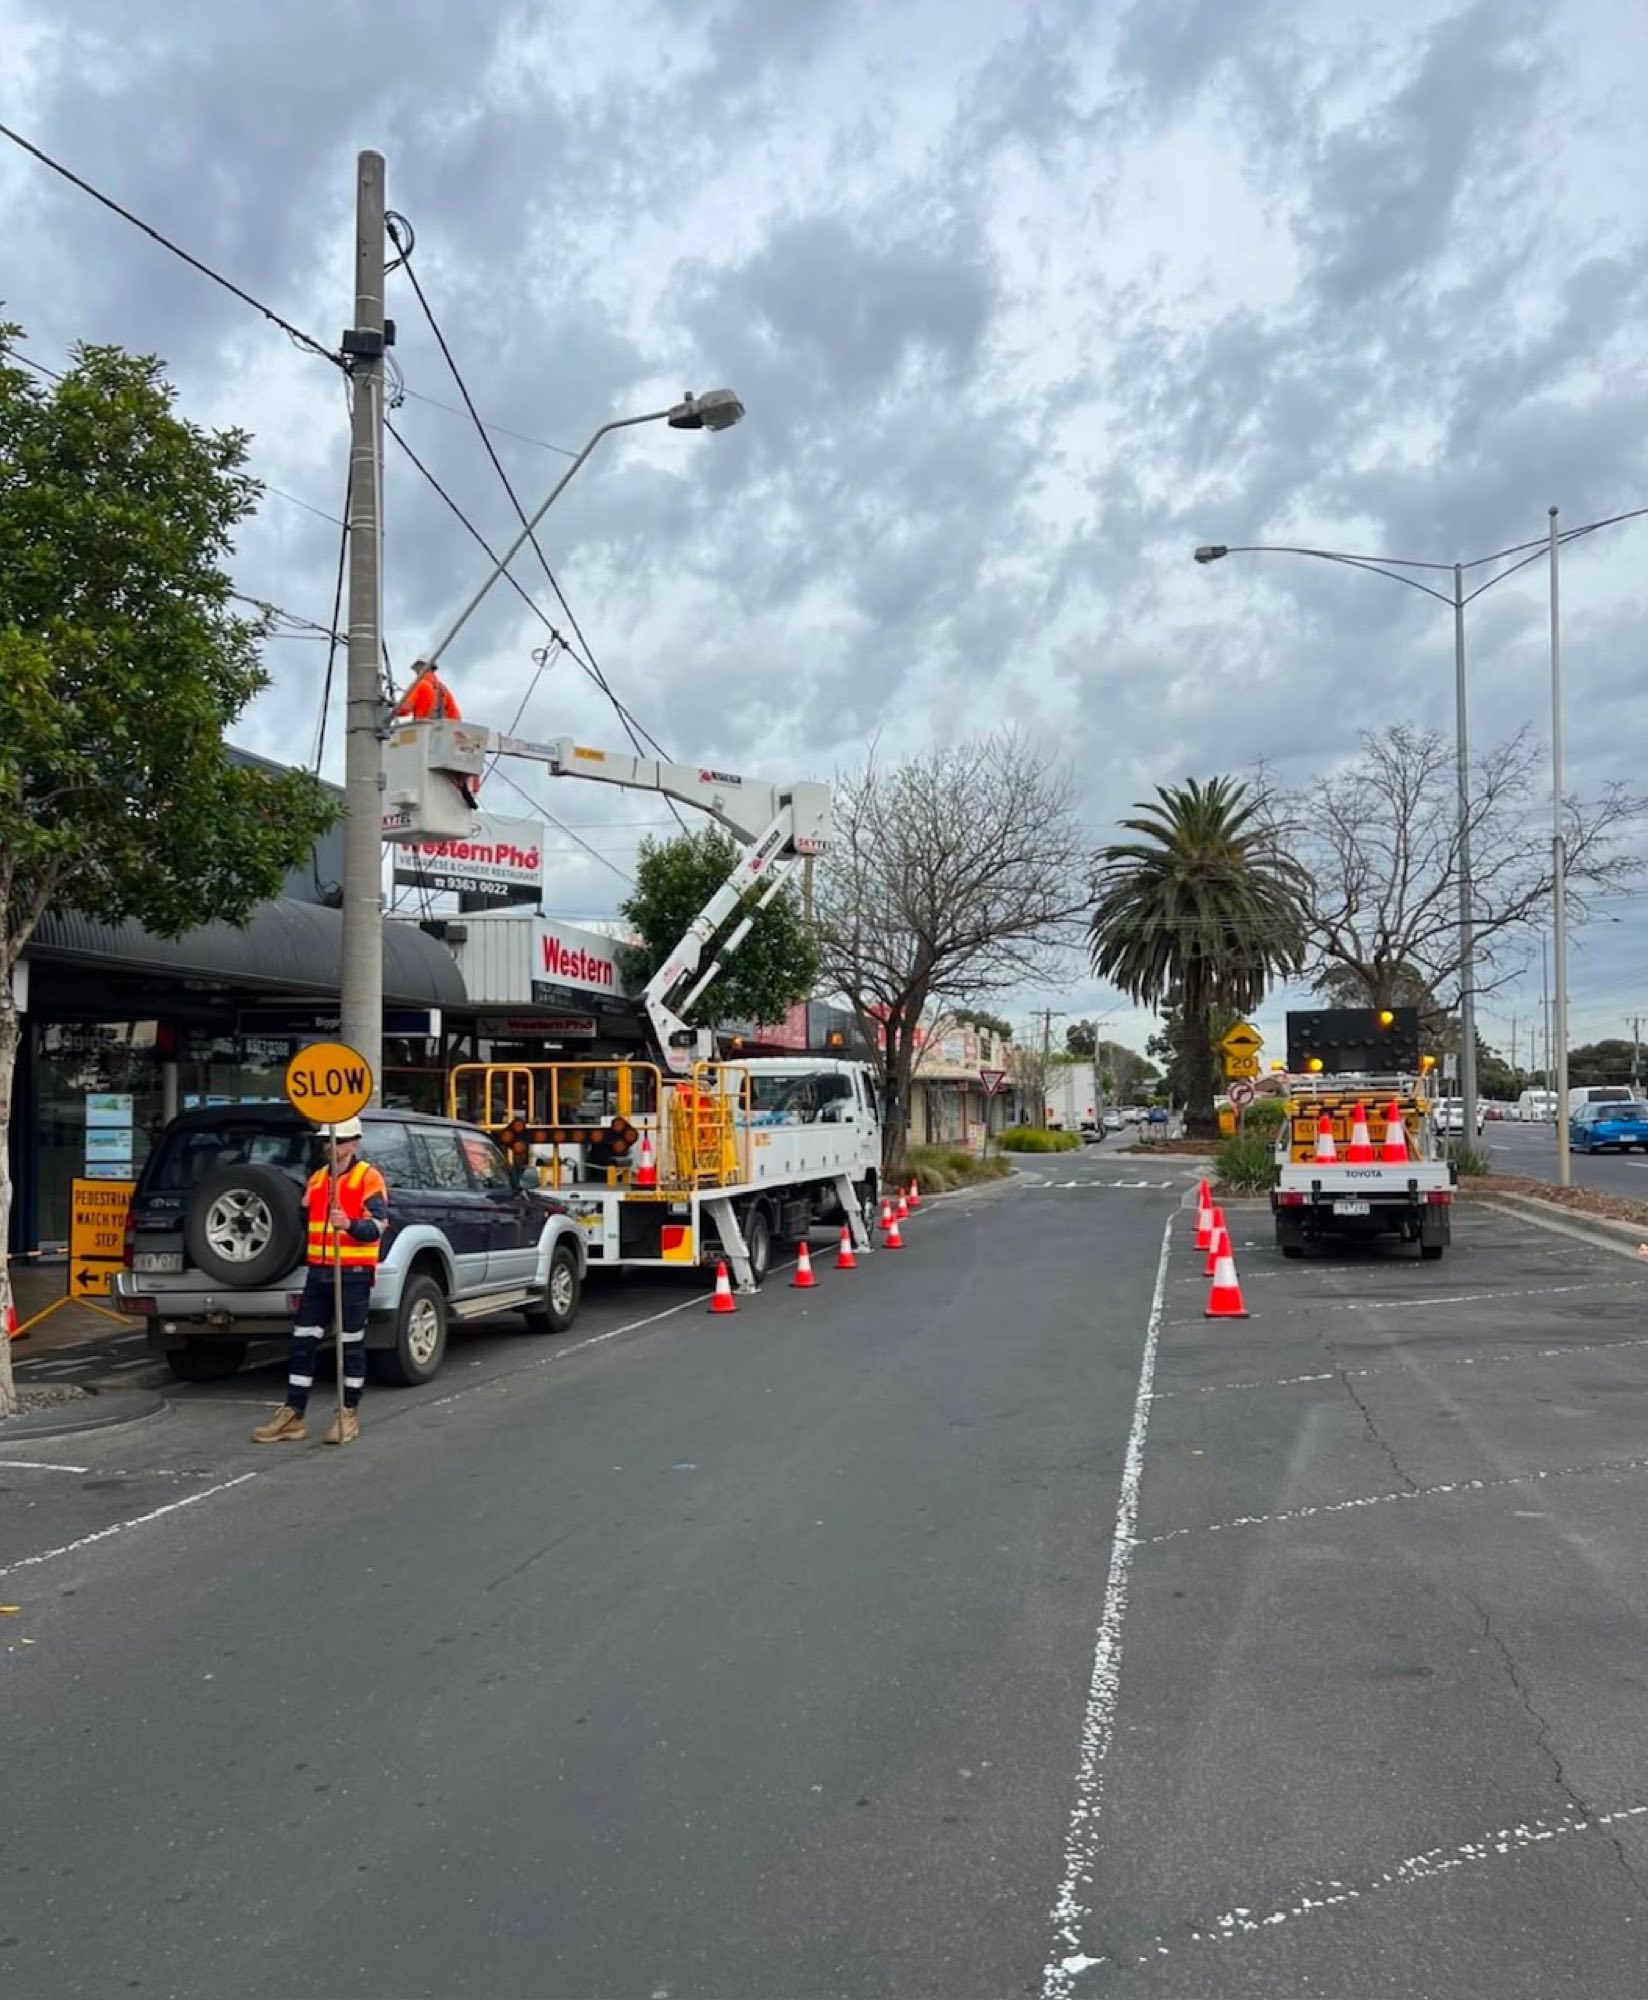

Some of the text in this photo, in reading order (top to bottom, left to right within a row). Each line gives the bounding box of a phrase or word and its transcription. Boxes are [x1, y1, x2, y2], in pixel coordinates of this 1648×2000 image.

[458, 863, 490, 876] CHINESE
[491, 867, 539, 880] RESTAURANT
[447, 877, 508, 896] 9363 0022
[543, 934, 614, 987] Western
[1232, 1058, 1252, 1070] 20
[292, 1068, 365, 1098] SLOW
[1344, 1169, 1383, 1179] TOYOTA
[77, 1212, 124, 1227] WATCH YO
[95, 1232, 118, 1248] STEP
